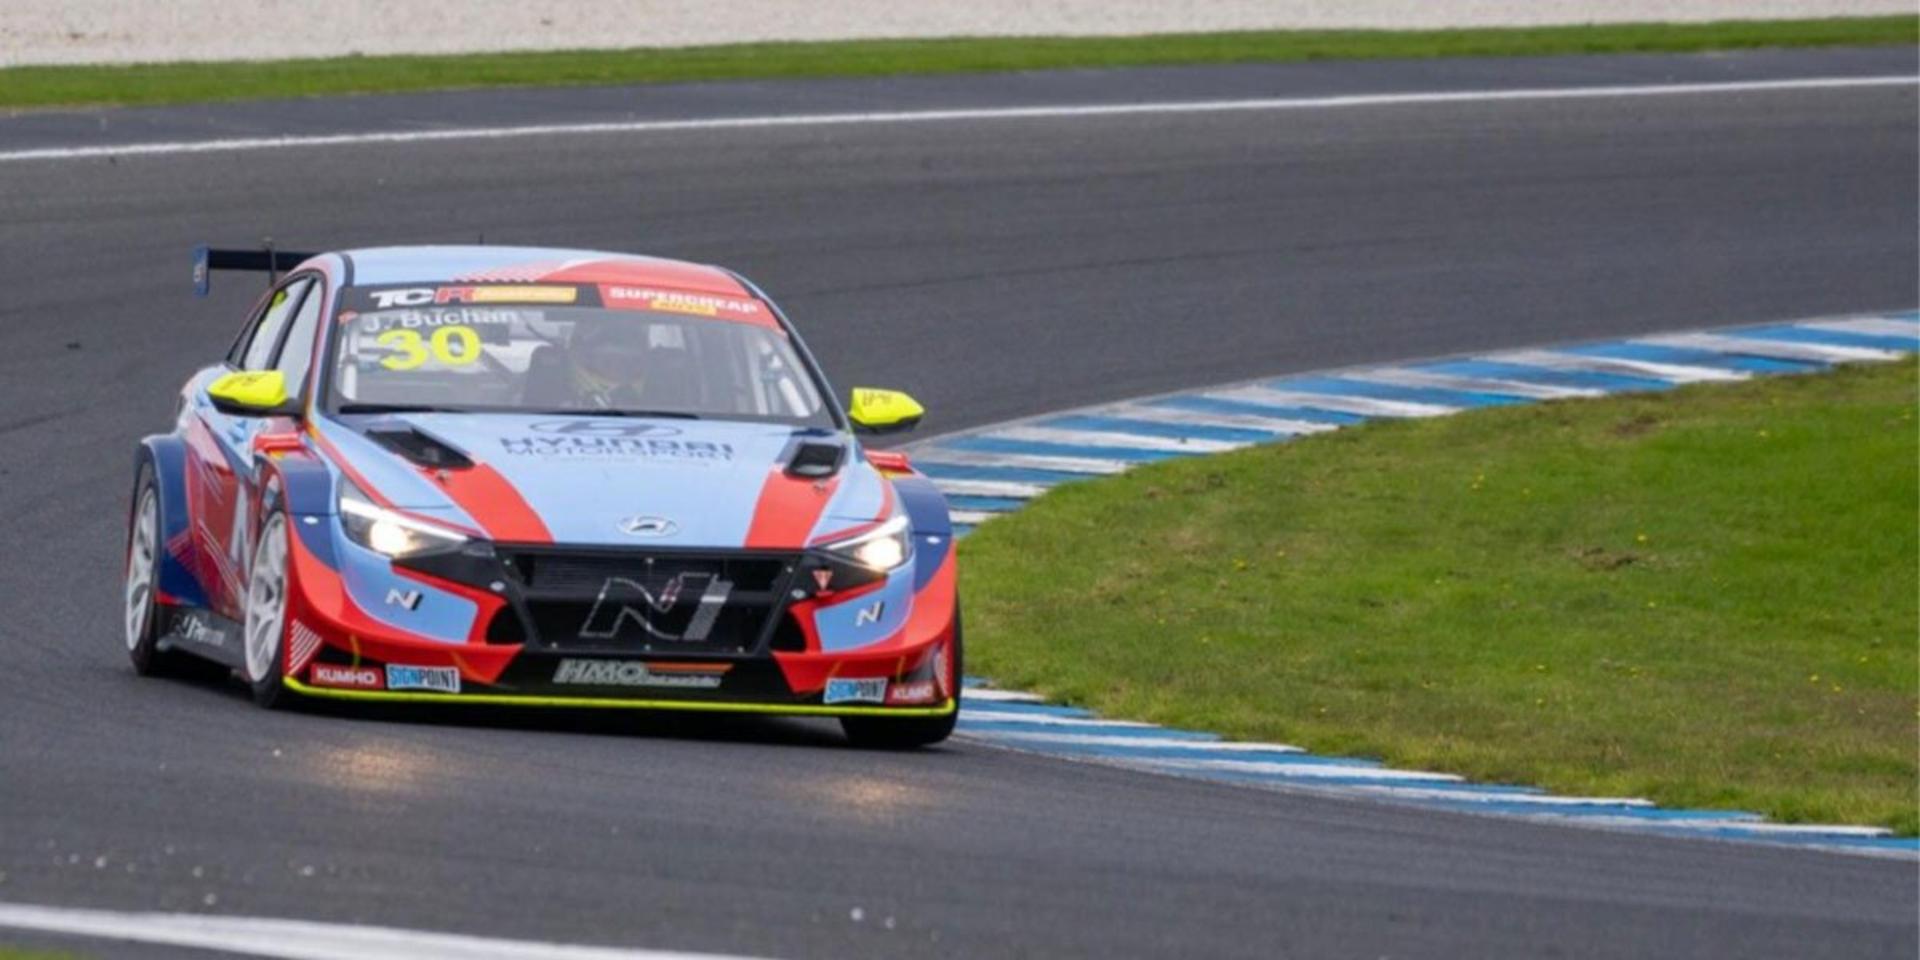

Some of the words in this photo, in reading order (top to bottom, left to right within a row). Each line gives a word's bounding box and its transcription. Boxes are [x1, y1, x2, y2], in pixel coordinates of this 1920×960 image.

[609, 287, 758, 313] SUPERCHEAP
[401, 306, 518, 328] Buchan
[375, 325, 480, 371] 30
[501, 437, 733, 455] HYUNDAI
[505, 447, 731, 461] MOTORSPORT
[316, 666, 377, 685] KUMHO
[389, 666, 458, 688] SIGNPOINT
[552, 658, 644, 684] HMO
